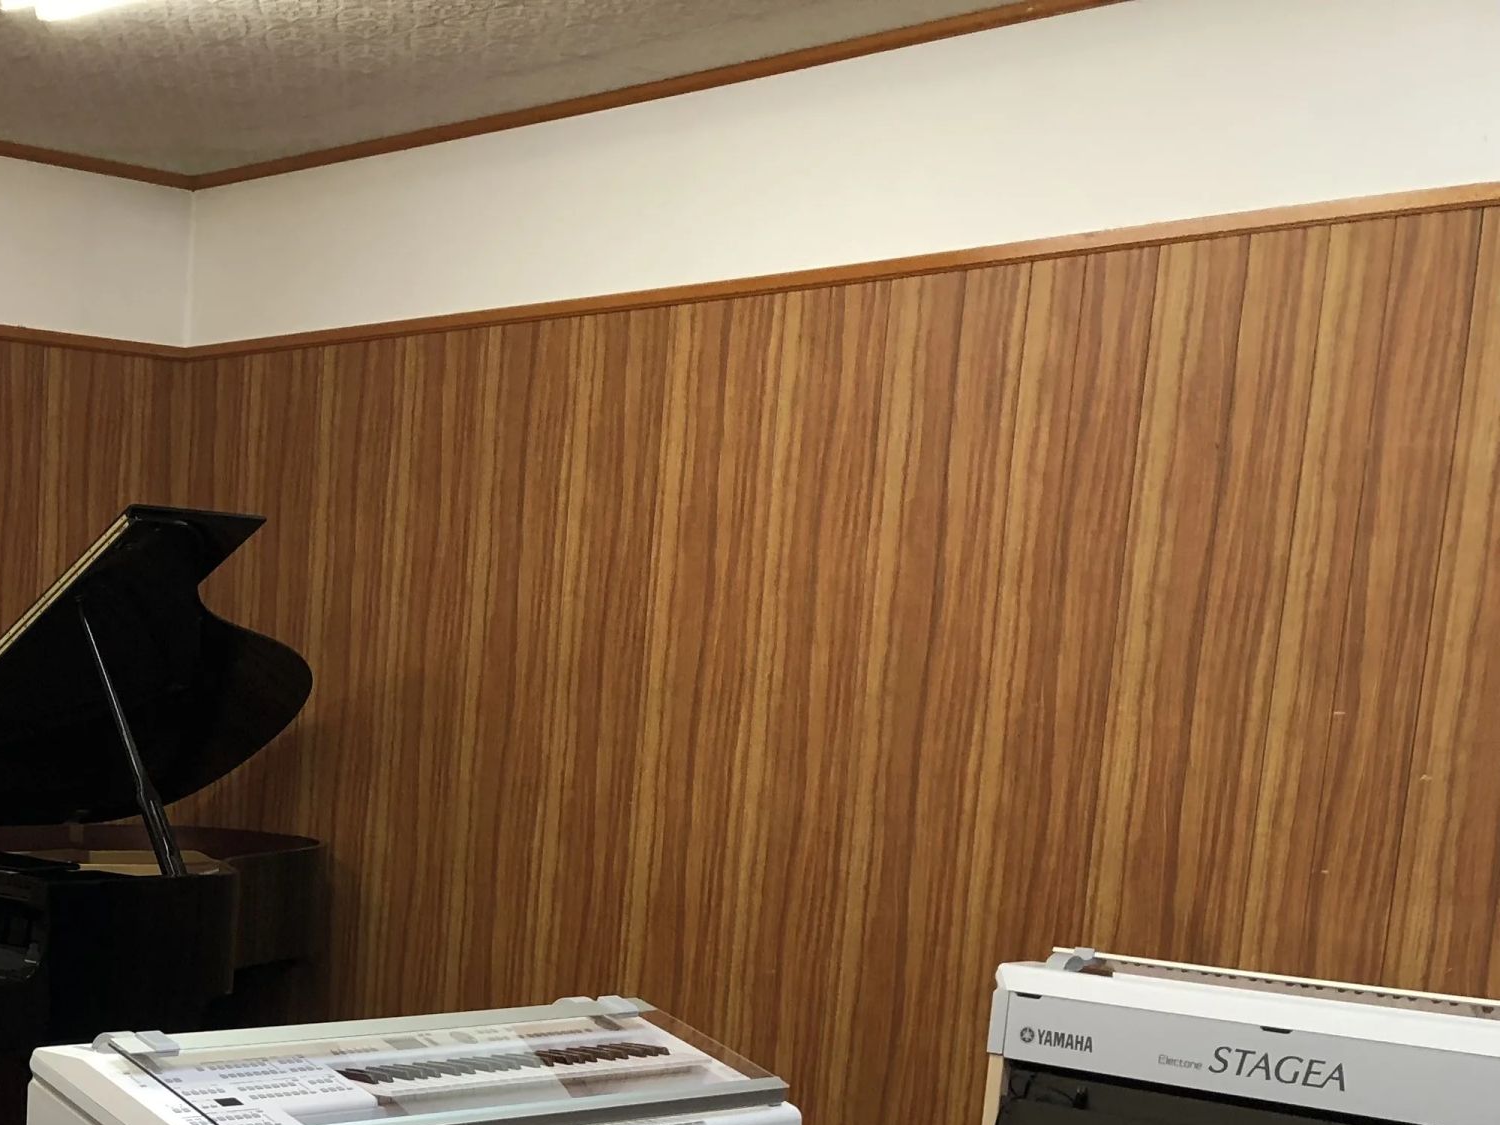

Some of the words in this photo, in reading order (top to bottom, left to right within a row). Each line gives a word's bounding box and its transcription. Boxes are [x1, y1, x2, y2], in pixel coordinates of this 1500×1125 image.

[1037, 1028, 1093, 1053] YAMAHA
[1157, 1053, 1203, 1071] Electone
[1208, 1046, 1346, 1092] STAGEA
